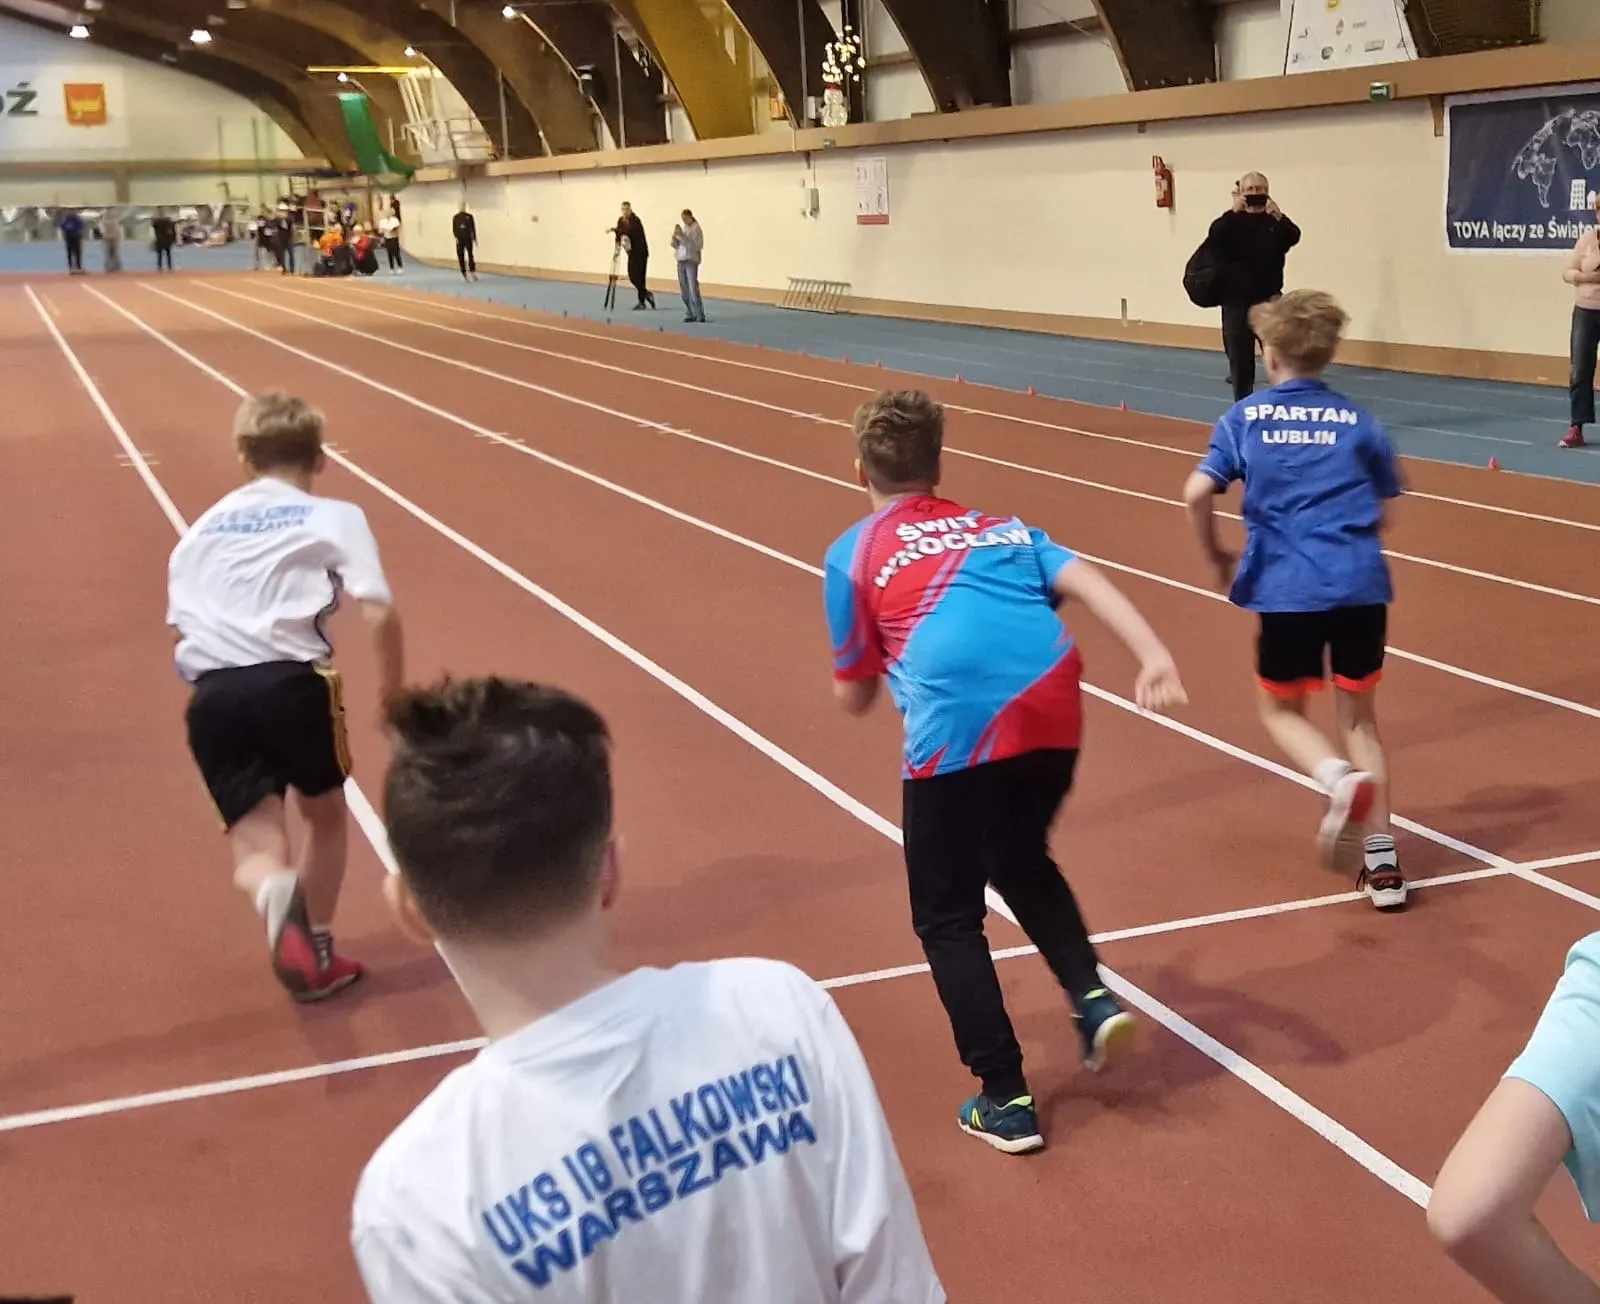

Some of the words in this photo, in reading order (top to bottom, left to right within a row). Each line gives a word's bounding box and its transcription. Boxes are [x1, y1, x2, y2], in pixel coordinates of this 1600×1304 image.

[1453, 221, 1490, 239] TOYA
[1493, 220, 1526, 242] łączy
[1529, 223, 1545, 239] ze
[1548, 216, 1600, 239] Świate
[1244, 404, 1358, 425] SPARTAN
[1262, 429, 1337, 445] LUBLIN
[482, 1171, 571, 1257] UKS
[608, 1053, 809, 1178] FALKOWSKI
[511, 1111, 817, 1290] WARSZAWA
